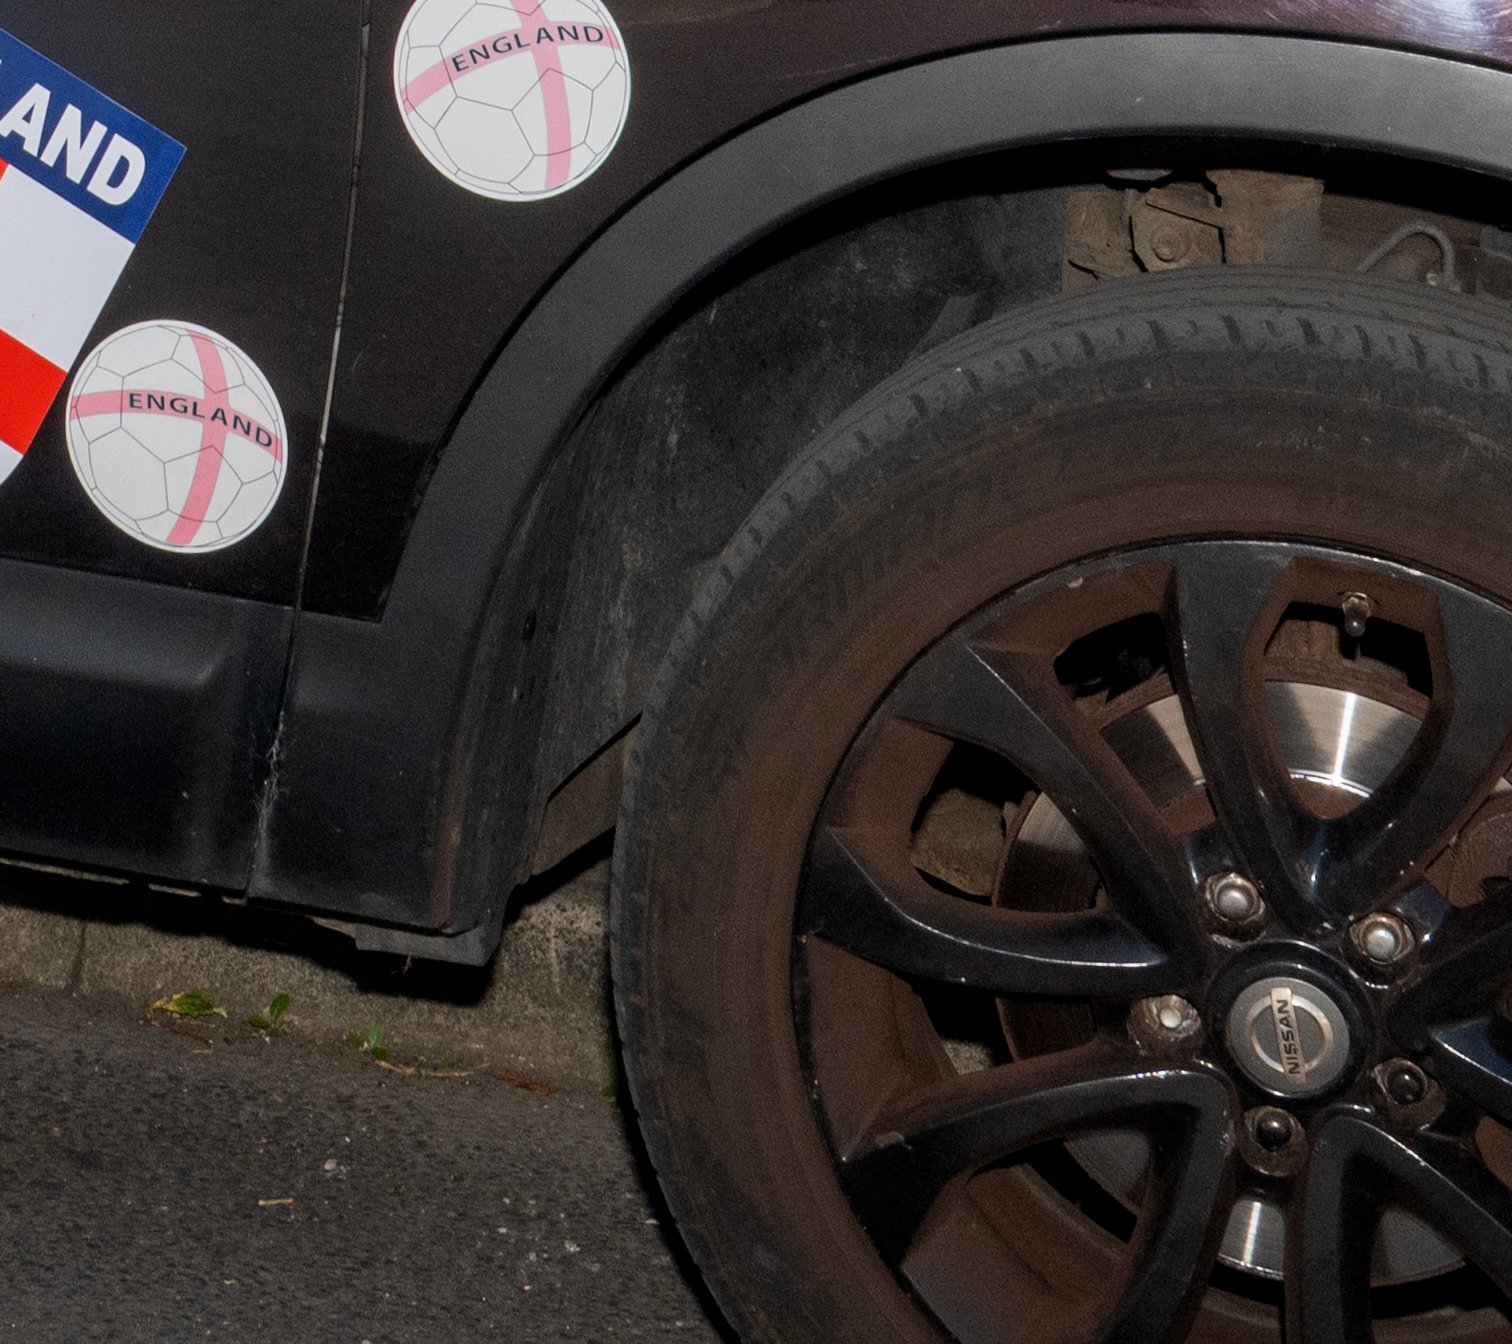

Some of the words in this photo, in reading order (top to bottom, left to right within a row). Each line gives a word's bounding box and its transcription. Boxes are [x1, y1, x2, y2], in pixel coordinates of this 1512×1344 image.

[452, 24, 605, 73] ENGLAND
[128, 391, 273, 449] ENGLAND
[1277, 999, 1301, 1075] NISSAN
